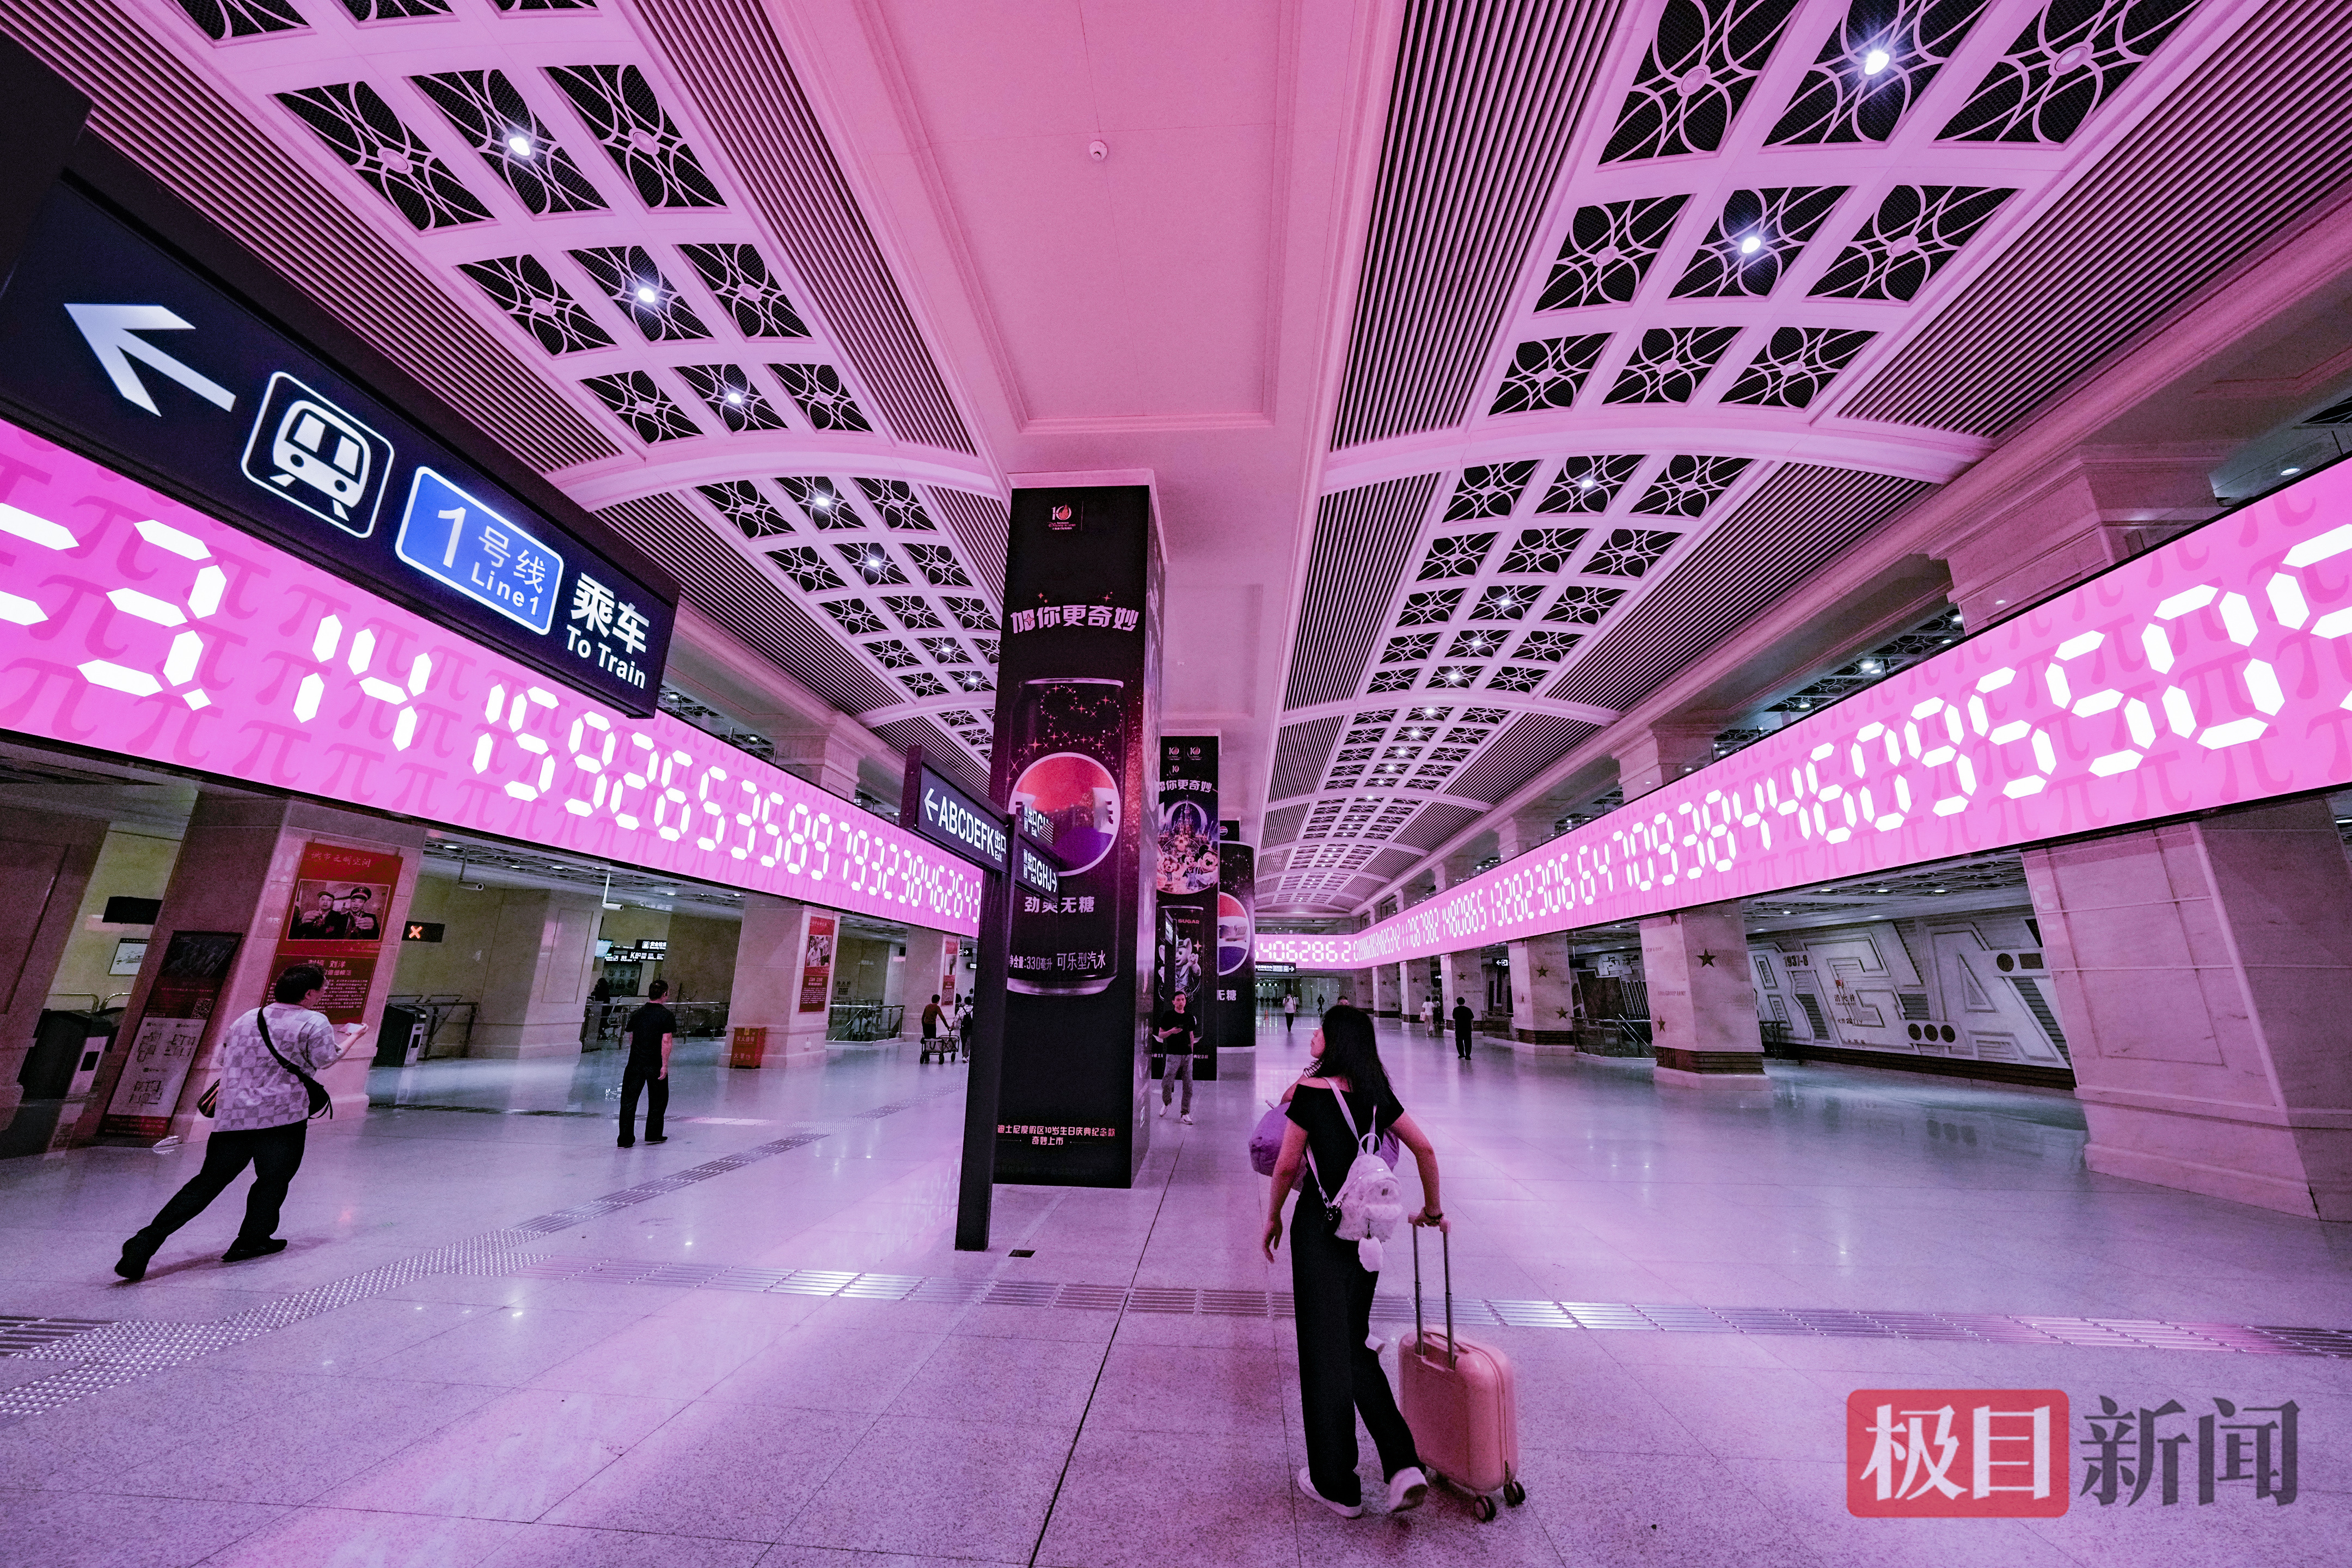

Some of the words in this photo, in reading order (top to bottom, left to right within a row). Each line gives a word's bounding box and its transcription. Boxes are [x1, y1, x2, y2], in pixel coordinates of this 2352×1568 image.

[437, 506, 546, 594] 1号线
[571, 572, 650, 655] 乘车
[567, 624, 591, 658] To
[598, 642, 646, 689] Train
[938, 796, 994, 856] ABCDEFK
[995, 830, 1006, 854] 出口
[1028, 853, 1037, 872] 出口
[1037, 860, 1052, 891] GHJ
[1057, 950, 1106, 971] 可乐型汽水
[1783, 954, 1809, 967] 1937-8
[1032, 1136, 1063, 1146] 奇妙上市
